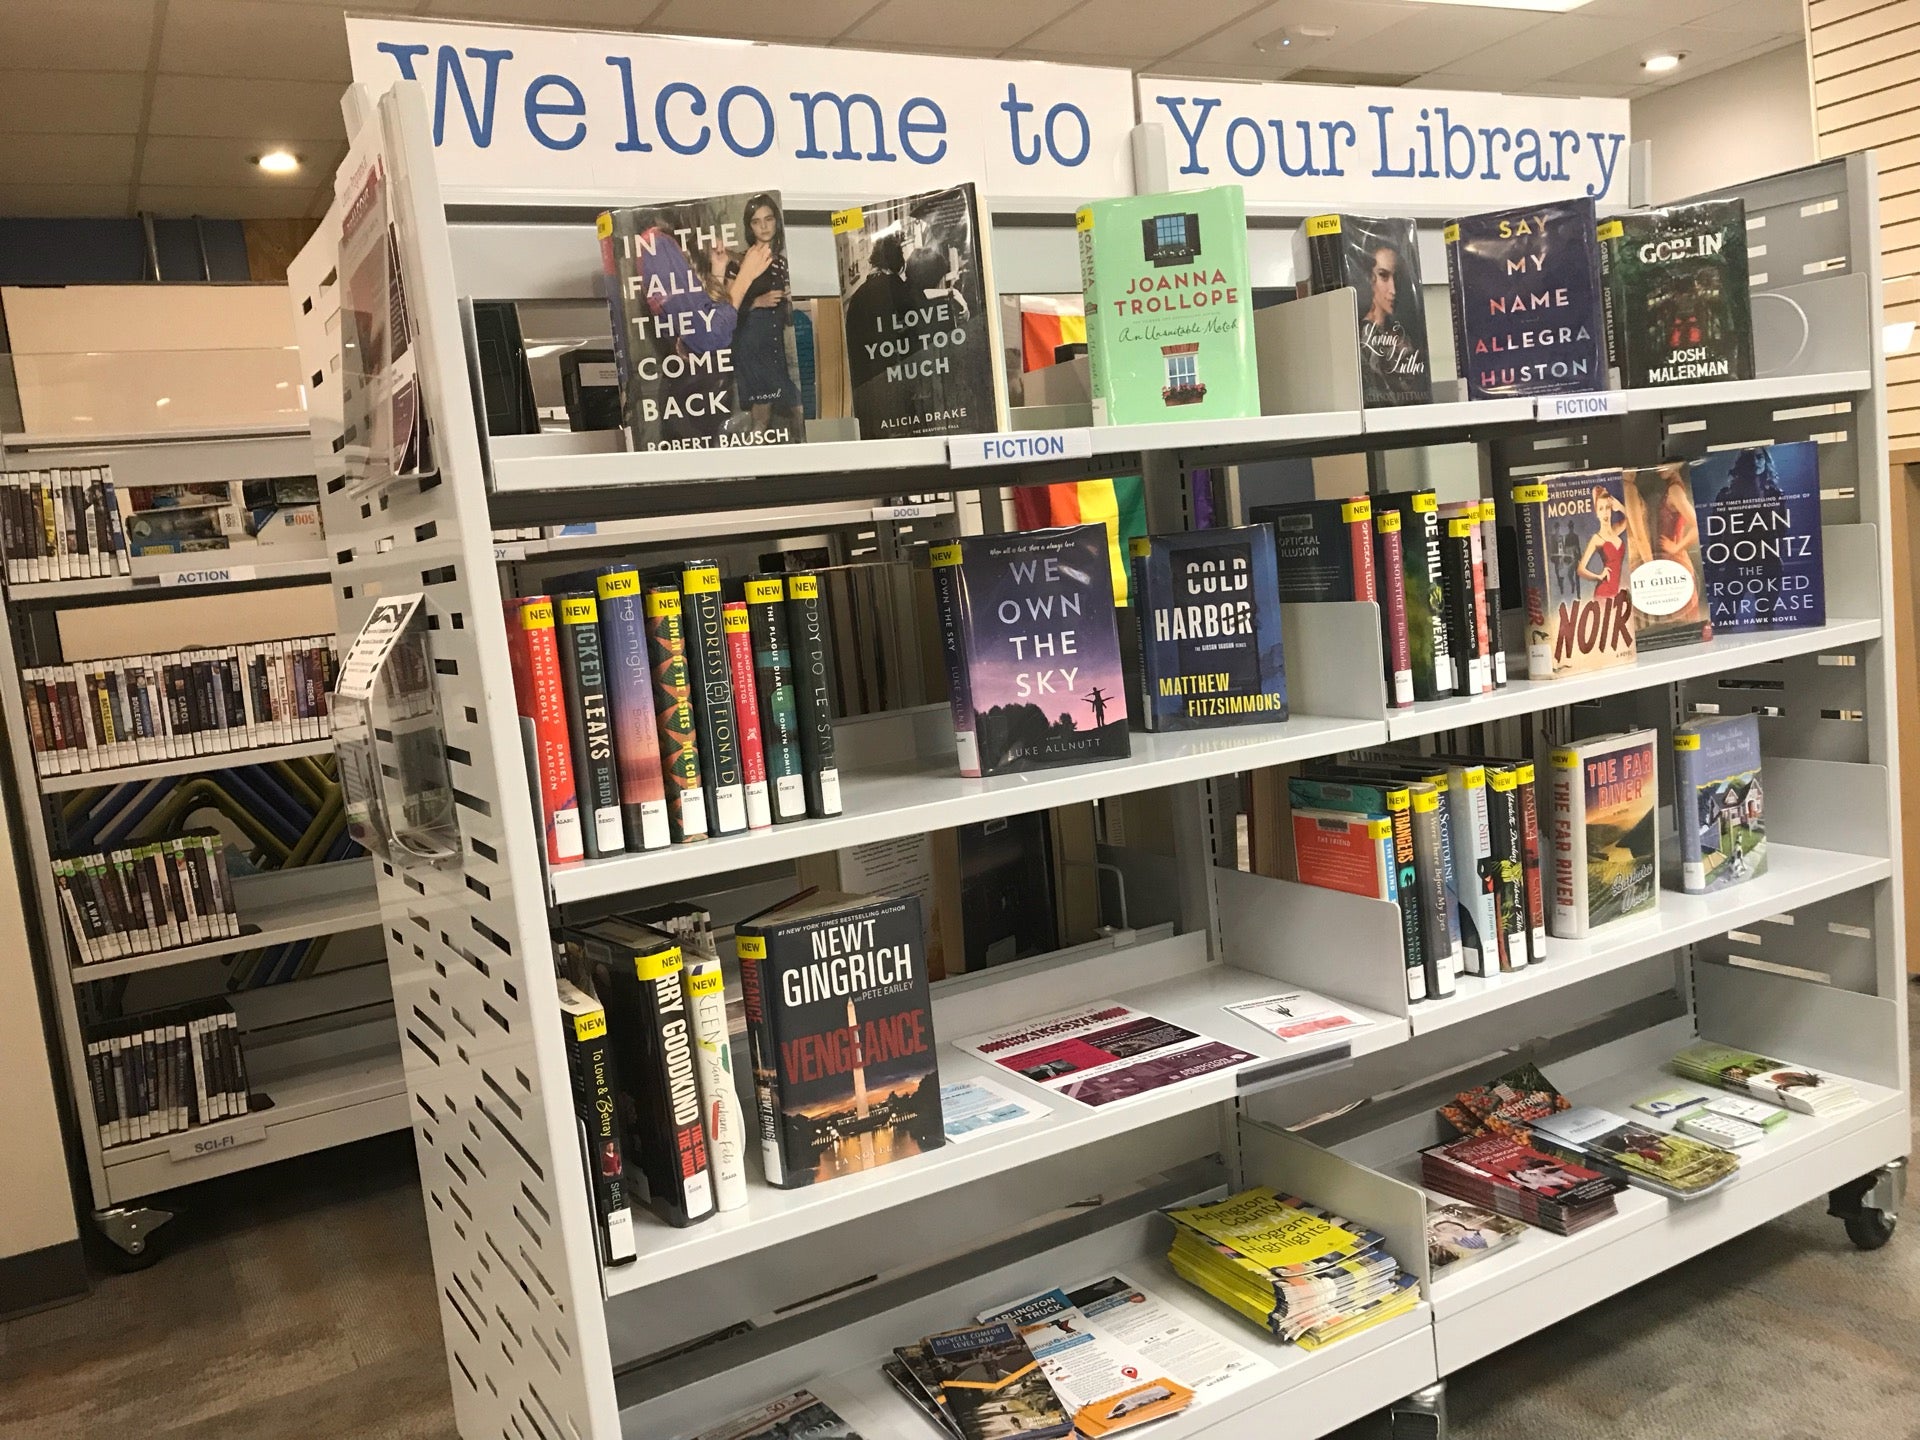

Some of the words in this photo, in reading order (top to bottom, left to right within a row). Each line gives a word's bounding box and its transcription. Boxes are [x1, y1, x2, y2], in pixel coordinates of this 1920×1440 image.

[377, 42, 948, 165] Welcome
[1001, 82, 1090, 167] to
[1156, 96, 1356, 177] Your
[1368, 105, 1626, 200] Library
[1317, 220, 1338, 229] NEW
[1499, 215, 1549, 239] SAY
[624, 232, 656, 259] IN
[674, 223, 738, 251] THE
[1639, 232, 1723, 265] GOBLIN
[1506, 253, 1547, 276] MY
[628, 270, 703, 300] FALL
[1126, 268, 1227, 294] JOANNA
[1114, 288, 1238, 316] TROLLOPE
[1489, 288, 1569, 315] NAME
[1600, 241, 1609, 275] GOBLIN
[1605, 307, 1616, 363] MALERMAN
[632, 309, 718, 340] THEY
[876, 316, 883, 333] I
[891, 304, 950, 331] LOVE
[1118, 328, 1142, 343] An
[1143, 323, 1201, 341] Unsuitable
[1203, 318, 1238, 334] Match
[864, 338, 910, 360] YOU
[918, 328, 966, 351] TOO
[1360, 322, 1401, 358] Loving
[1475, 325, 1590, 354] ALLEGRA
[638, 349, 734, 381] COME
[1668, 346, 1707, 364] JOSH
[886, 358, 950, 383] MUCH
[1481, 358, 1588, 386] HUSTON
[1648, 360, 1729, 383] MALERMAN
[642, 391, 731, 422] BACK
[880, 412, 920, 429] ALICIA
[925, 407, 967, 422] DRAKE
[1556, 396, 1608, 415] FICTION
[647, 438, 712, 452] ROBERT
[718, 428, 789, 448] BAUSCH
[983, 436, 1064, 460] FICTION
[1547, 487, 1591, 500] CHRISTOPHER
[893, 507, 920, 518] DOCU
[1353, 505, 1369, 514] NEW
[1548, 498, 1592, 519] MOORE
[1383, 518, 1399, 527] NEW
[1707, 508, 1791, 536] DEAN
[932, 551, 952, 561] NEW
[1281, 547, 1319, 557] ILLUSION
[1426, 541, 1442, 583] HILL
[1527, 552, 1536, 578] MOORE
[177, 570, 230, 584] ACTION
[1008, 557, 1060, 585] WE
[1187, 558, 1248, 595] COLD
[1633, 580, 1646, 589] IT
[1650, 574, 1687, 587] GIRLS
[1738, 565, 1763, 576] THE
[606, 579, 631, 591] NEW
[757, 586, 780, 596] NEW
[795, 582, 817, 592] NEW
[940, 577, 949, 603] OWN
[1393, 563, 1406, 611] SOLSTICE
[566, 605, 590, 616] NEW
[659, 599, 681, 609] NEW
[767, 605, 775, 622] THE
[998, 593, 1081, 625] OWN
[724, 616, 748, 626] NEW
[944, 607, 953, 628] THE
[1154, 601, 1253, 642] HARBOR
[1554, 589, 1633, 664] NOIR
[1772, 615, 1798, 623] NOVEL
[701, 594, 723, 676] ADDRESS
[769, 626, 779, 661] PLAGUE
[947, 631, 956, 651] SKY
[1009, 630, 1077, 660] THE
[626, 639, 645, 686] night
[673, 655, 683, 668] OF
[674, 672, 686, 692] THE
[738, 662, 747, 704] MISTLETOE
[774, 665, 784, 702] DIARIES
[1016, 667, 1079, 698] SKY
[1159, 673, 1230, 697] MATTHEW
[132, 696, 144, 735] BOULEVARD
[178, 696, 189, 724] CAROL
[548, 680, 560, 725] ALWAYS
[677, 696, 690, 730] ASHES
[1189, 693, 1281, 717] FITZSIMMONS
[584, 694, 610, 760] LEAKS
[715, 710, 732, 764] FIONA
[779, 712, 788, 745] RONLYN
[683, 740, 693, 760] MIA
[1008, 745, 1039, 759] LUKE
[1045, 738, 1101, 754] ALLNUTT
[1552, 755, 1568, 763] NEW
[557, 744, 567, 783] DANIEL
[1588, 759, 1618, 787] THE
[1623, 751, 1653, 779] FAR
[1435, 779, 1448, 787] NEW
[1467, 775, 1482, 783] NEW
[1496, 777, 1511, 786] NEW
[1389, 796, 1406, 805] NEW
[1554, 782, 1570, 812] THE
[1598, 778, 1644, 809] RIVER
[1440, 813, 1453, 882] SCOTTOLINE
[1554, 820, 1571, 851] FAR
[1432, 842, 1441, 866] There
[1387, 862, 1395, 891] FRIEND
[1433, 869, 1443, 895] Before
[1555, 859, 1574, 906] RIVER
[1611, 863, 1653, 897] Barbara
[1435, 896, 1445, 910] My
[786, 926, 801, 935] NEW
[802, 922, 819, 931] YORK
[821, 919, 839, 927] TIMES
[840, 910, 879, 923] BESTSELLING
[881, 904, 906, 915] AUTHOR
[1436, 913, 1446, 932] Eyes
[741, 943, 760, 952] NEW
[811, 919, 876, 960] NEWT
[662, 956, 682, 968] NEW
[693, 978, 717, 990] NEW
[782, 943, 913, 1008] GINGRICH
[862, 988, 882, 1001] PETE
[884, 981, 914, 995] EARLEY
[580, 1017, 604, 1032] NEW
[593, 1049, 603, 1062] To
[781, 1009, 928, 1085] VENGEANCE
[594, 1063, 604, 1086] Love
[662, 1019, 699, 1125] GOODKIND
[597, 1087, 602, 1095] &
[595, 1095, 614, 1137] Betray
[194, 1136, 234, 1153] SCI-FI
[691, 1123, 702, 1141] THE
[1191, 1194, 1269, 1223] Arlington
[1219, 1200, 1284, 1227] County
[1214, 1221, 1269, 1239] Public
[1269, 1208, 1301, 1223] Art
[1237, 1214, 1314, 1245] Program
[1241, 1222, 1332, 1256] Highlights
[994, 1296, 1057, 1322] ARLINGTON
[936, 1334, 968, 1347] BICYCLE
[970, 1326, 1006, 1340] COMFORT
[952, 1339, 976, 1349] LEVEL
[978, 1336, 995, 1346] MAP
